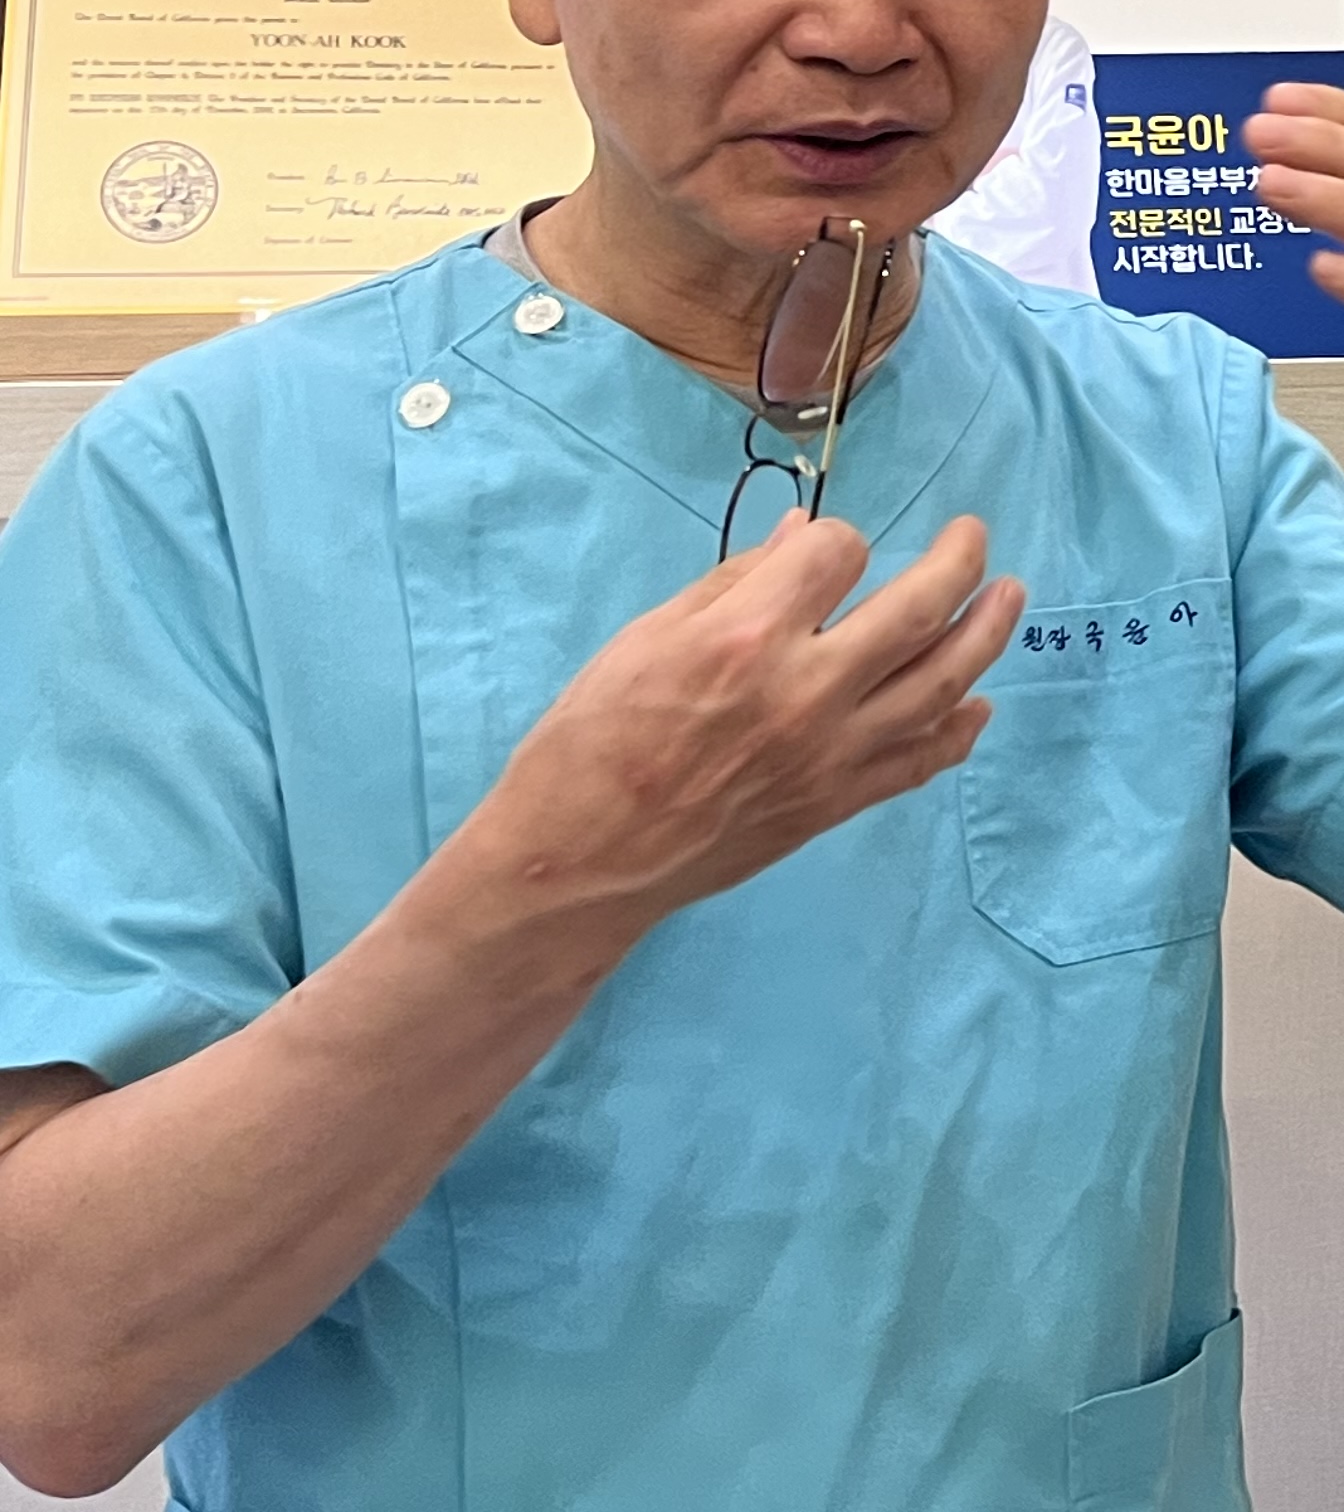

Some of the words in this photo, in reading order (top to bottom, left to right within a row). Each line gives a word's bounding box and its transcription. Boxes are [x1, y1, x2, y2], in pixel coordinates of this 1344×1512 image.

[350, 35, 407, 49] KOOK
[1104, 114, 1229, 157] 국윤아
[1109, 207, 1223, 239] 전문적인
[1113, 242, 1263, 274] 시작합니다.
